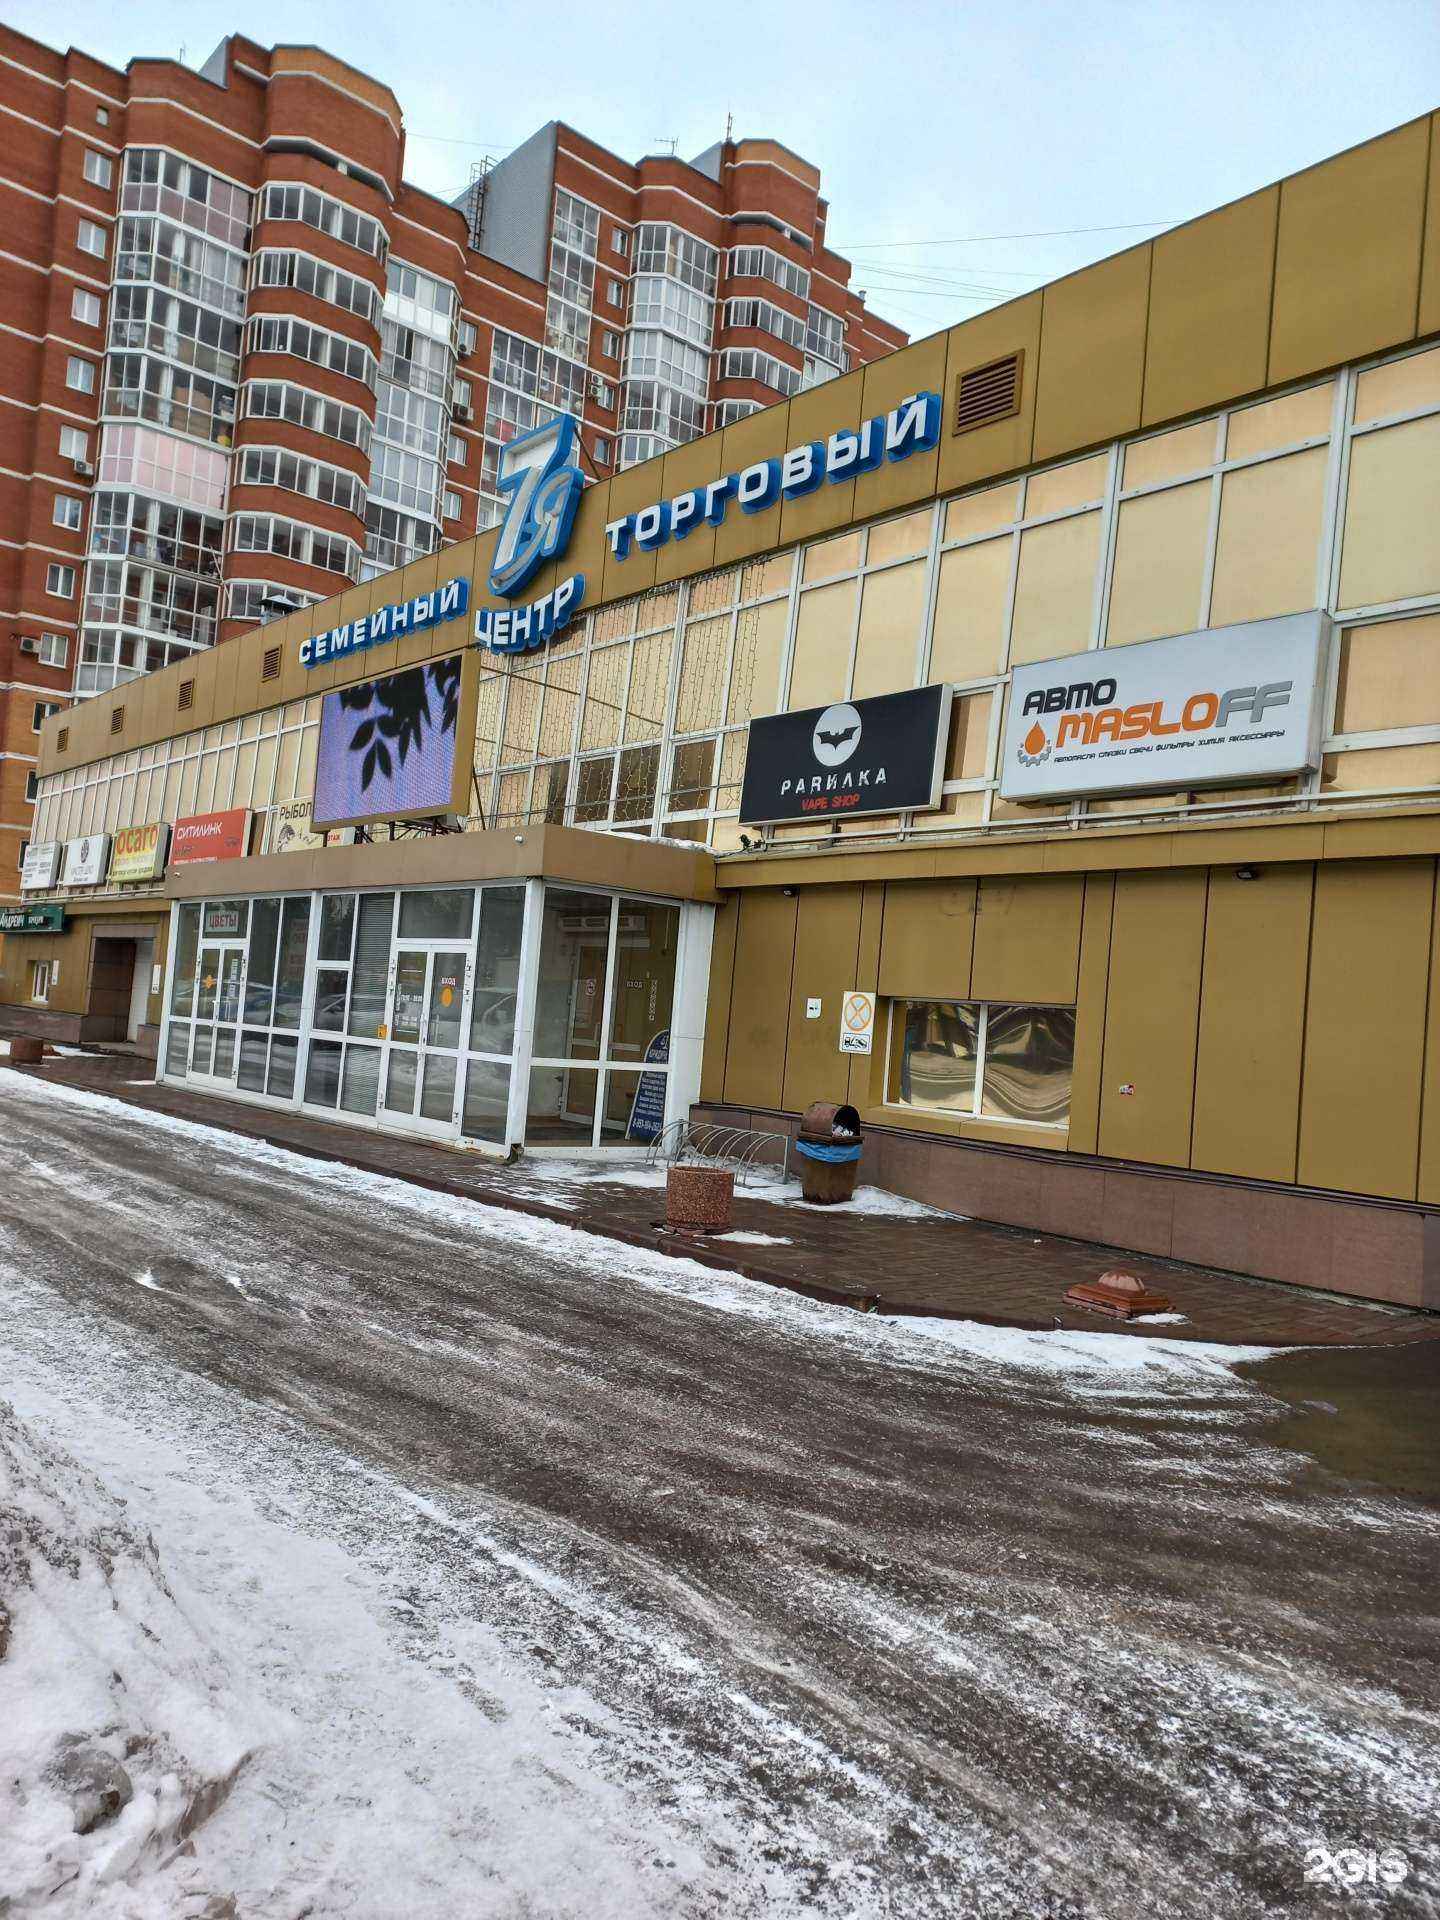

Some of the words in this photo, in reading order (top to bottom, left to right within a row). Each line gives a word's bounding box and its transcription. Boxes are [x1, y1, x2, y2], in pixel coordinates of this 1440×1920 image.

[605, 392, 936, 556] ТОРГОВЫЙ
[298, 578, 464, 666] СЕМЕЙНЫЙ
[475, 575, 582, 650] ЦЕНТР
[1056, 681, 1293, 748] MASLOFF
[280, 802, 312, 819] РЫБОЛ
[801, 798, 828, 810] VAPE
[832, 793, 860, 808] SHOP
[177, 822, 223, 840] СИТИЛИНК
[209, 913, 237, 929] ЦВЕТЫ
